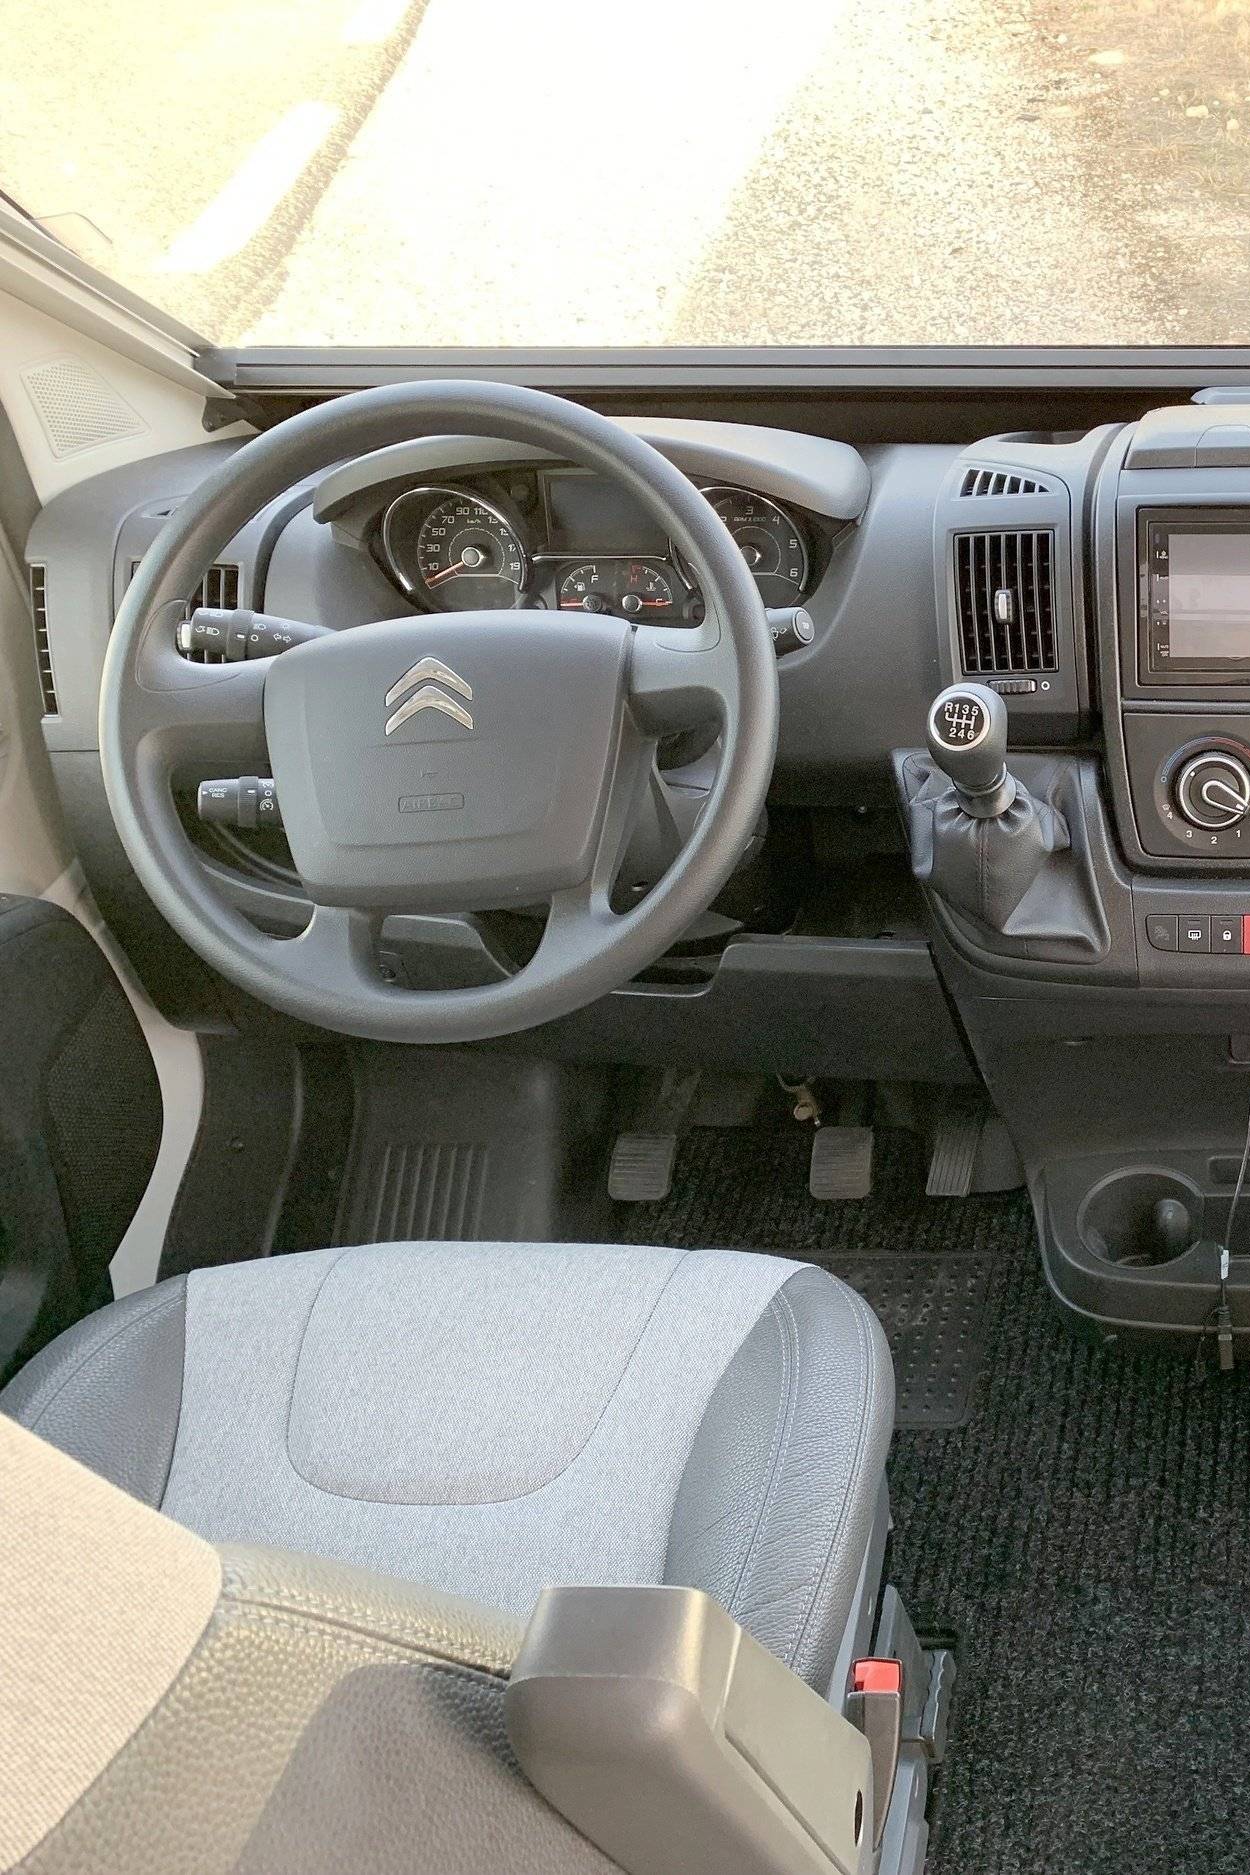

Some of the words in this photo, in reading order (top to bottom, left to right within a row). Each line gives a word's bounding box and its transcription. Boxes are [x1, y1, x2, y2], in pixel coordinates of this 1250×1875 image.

[456, 507, 470, 515] 90
[745, 505, 754, 515] 3
[441, 515, 455, 524] 70
[772, 515, 780, 525] 4
[431, 527, 446, 536] 50
[426, 544, 440, 552] 30
[788, 539, 798, 548] 5
[427, 562, 439, 571] 10
[789, 567, 799, 577] 6
[591, 574, 599, 583] F
[1166, 811, 1173, 820] 4
[1186, 830, 1193, 838] 3
[1236, 829, 1241, 838] 1
[1210, 836, 1218, 844] 2
